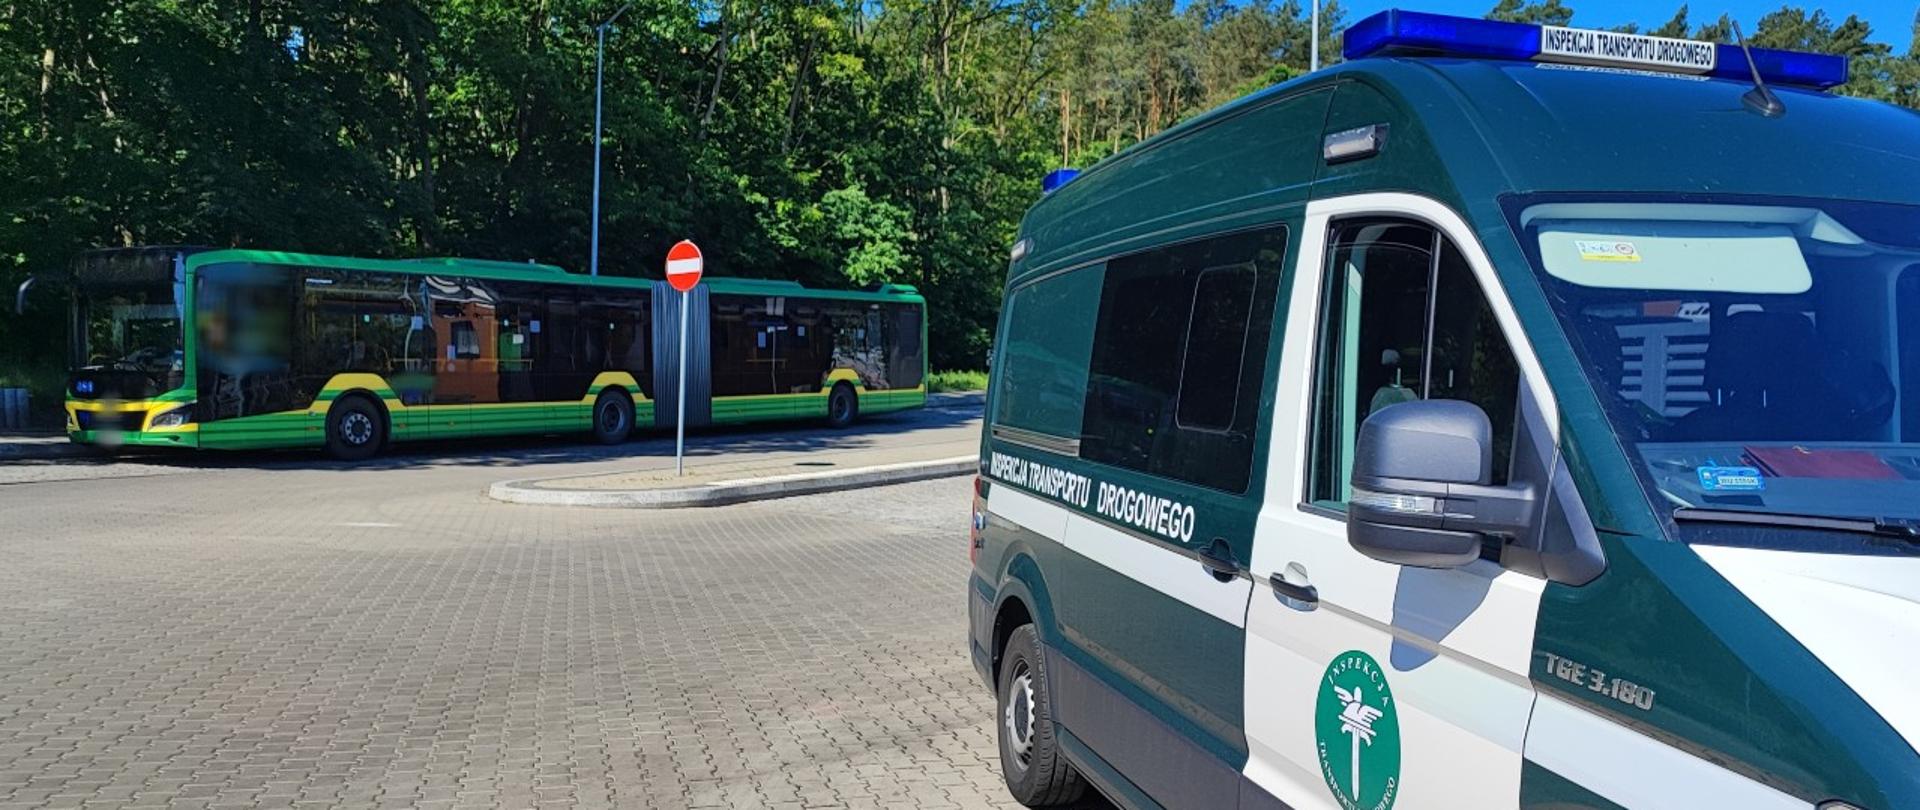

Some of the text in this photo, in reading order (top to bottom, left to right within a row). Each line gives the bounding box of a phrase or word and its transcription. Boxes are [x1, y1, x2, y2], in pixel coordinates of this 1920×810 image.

[1545, 29, 1712, 66] INSPEKCJA TRANSPORTU DROGOWEGO
[990, 451, 1195, 543] INSPEKCJA TRANSPORTU DROGOWEGO
[1328, 657, 1389, 707] INSPEKCJA
[1545, 652, 1656, 710] TGE 3.180
